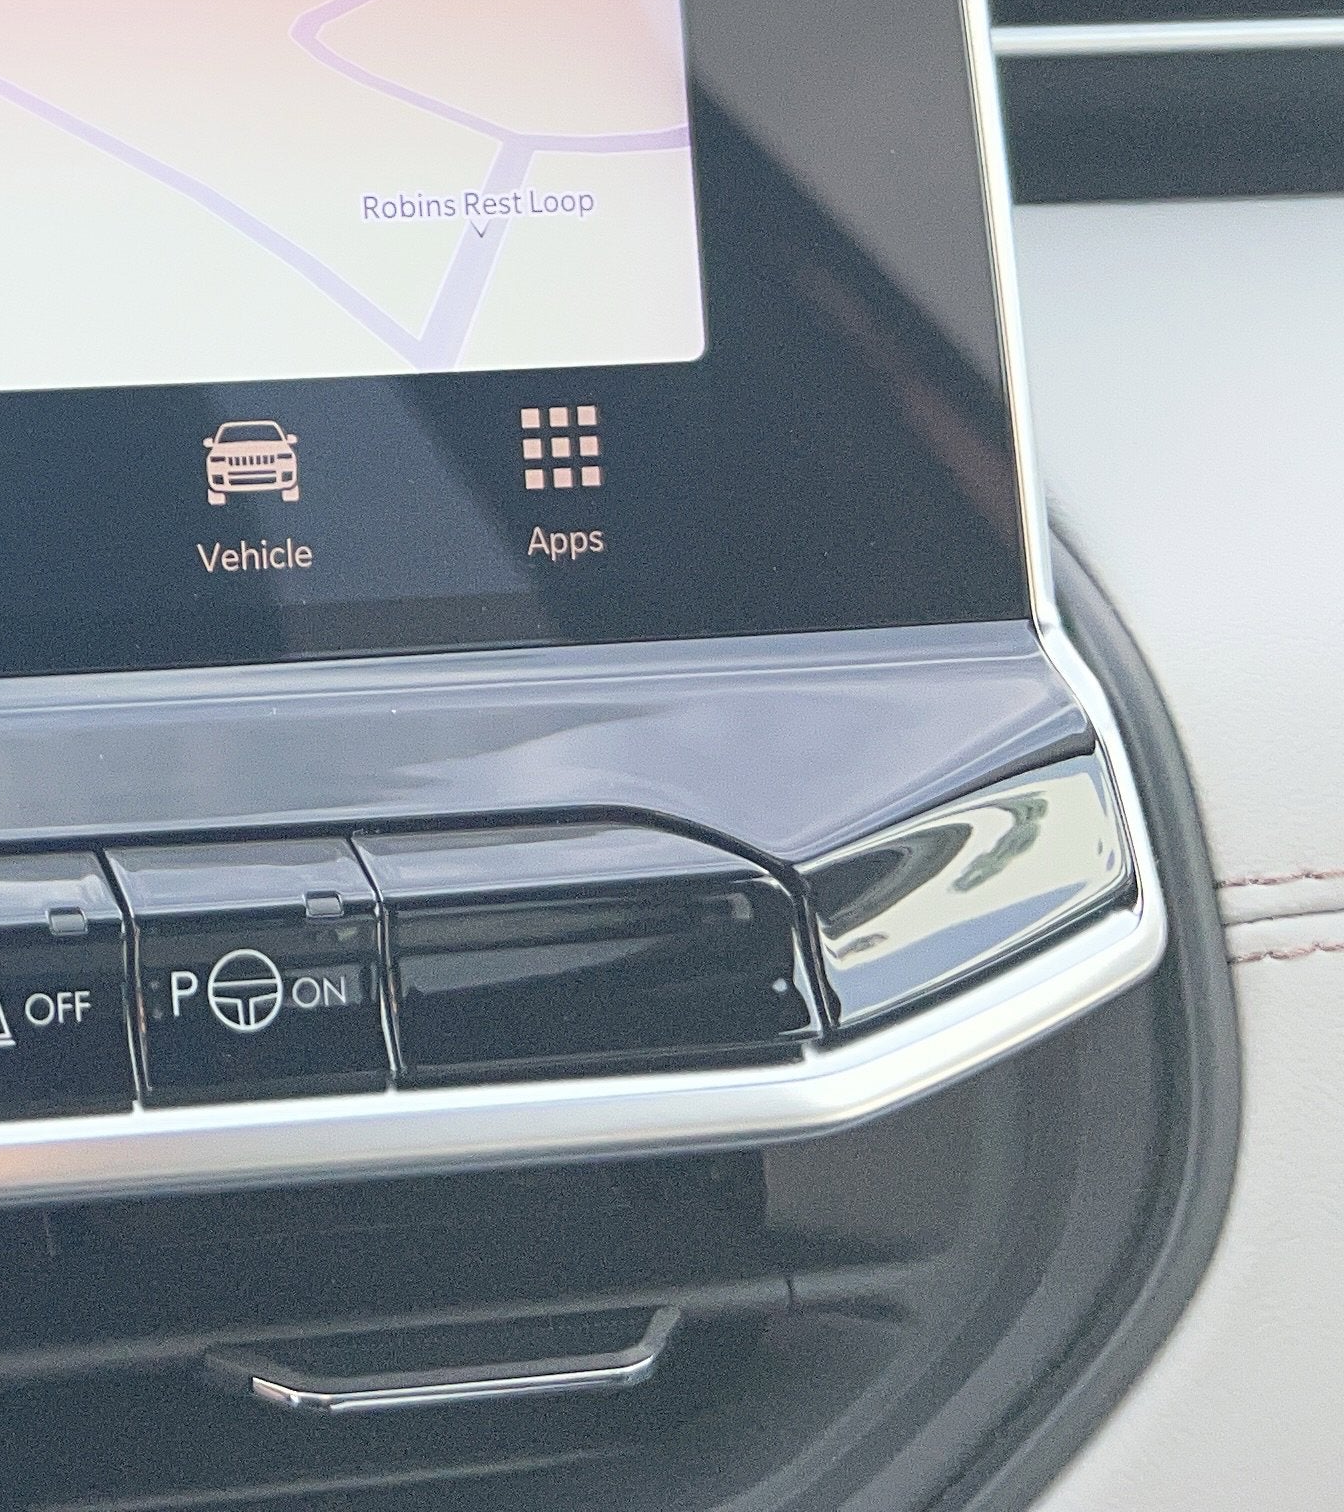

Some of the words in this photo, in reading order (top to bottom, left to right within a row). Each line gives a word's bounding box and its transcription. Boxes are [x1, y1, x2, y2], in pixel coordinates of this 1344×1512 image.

[362, 192, 457, 219] Robins
[463, 190, 523, 216] Rest
[529, 190, 595, 218] Loop
[196, 540, 314, 573] Vehicle
[526, 524, 606, 561] Apps
[25, 988, 93, 1028] OFF
[171, 970, 199, 1017] P
[292, 976, 348, 1008] ON
